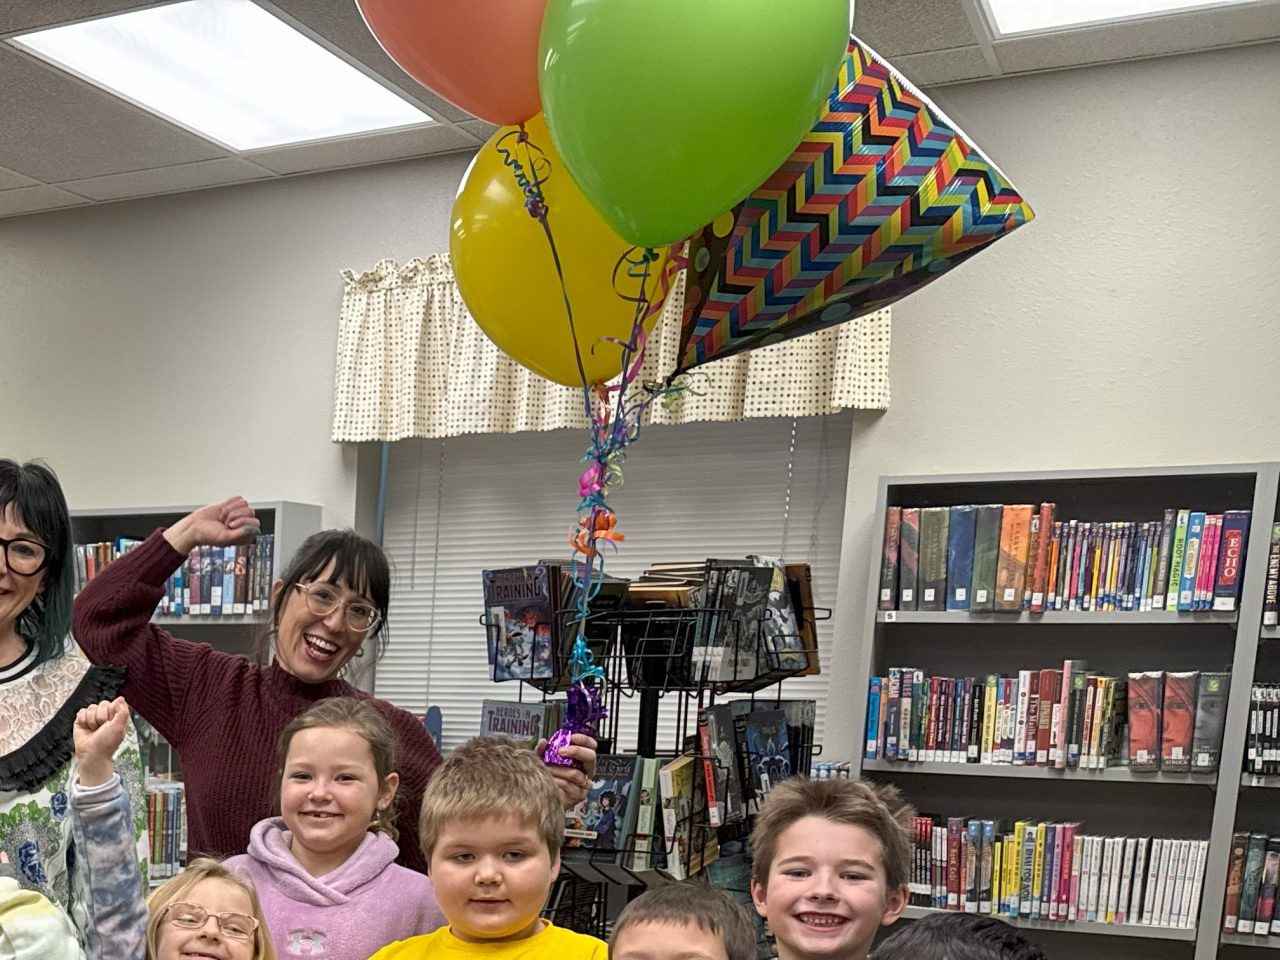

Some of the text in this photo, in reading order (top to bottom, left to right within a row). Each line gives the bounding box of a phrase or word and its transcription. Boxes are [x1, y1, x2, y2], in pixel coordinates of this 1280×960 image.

[1224, 537, 1240, 578] ECHO
[1268, 554, 1280, 579] ENEMY
[1170, 561, 1181, 587] MAGIC
[489, 576, 541, 600] TRAINING
[1266, 580, 1278, 604] ABOVE
[902, 673, 912, 698] HOLES
[488, 710, 541, 735] TRAINING
[496, 707, 520, 719] HEROES
[1027, 697, 1038, 741] The Mailbo
[1023, 868, 1032, 882] FOR
